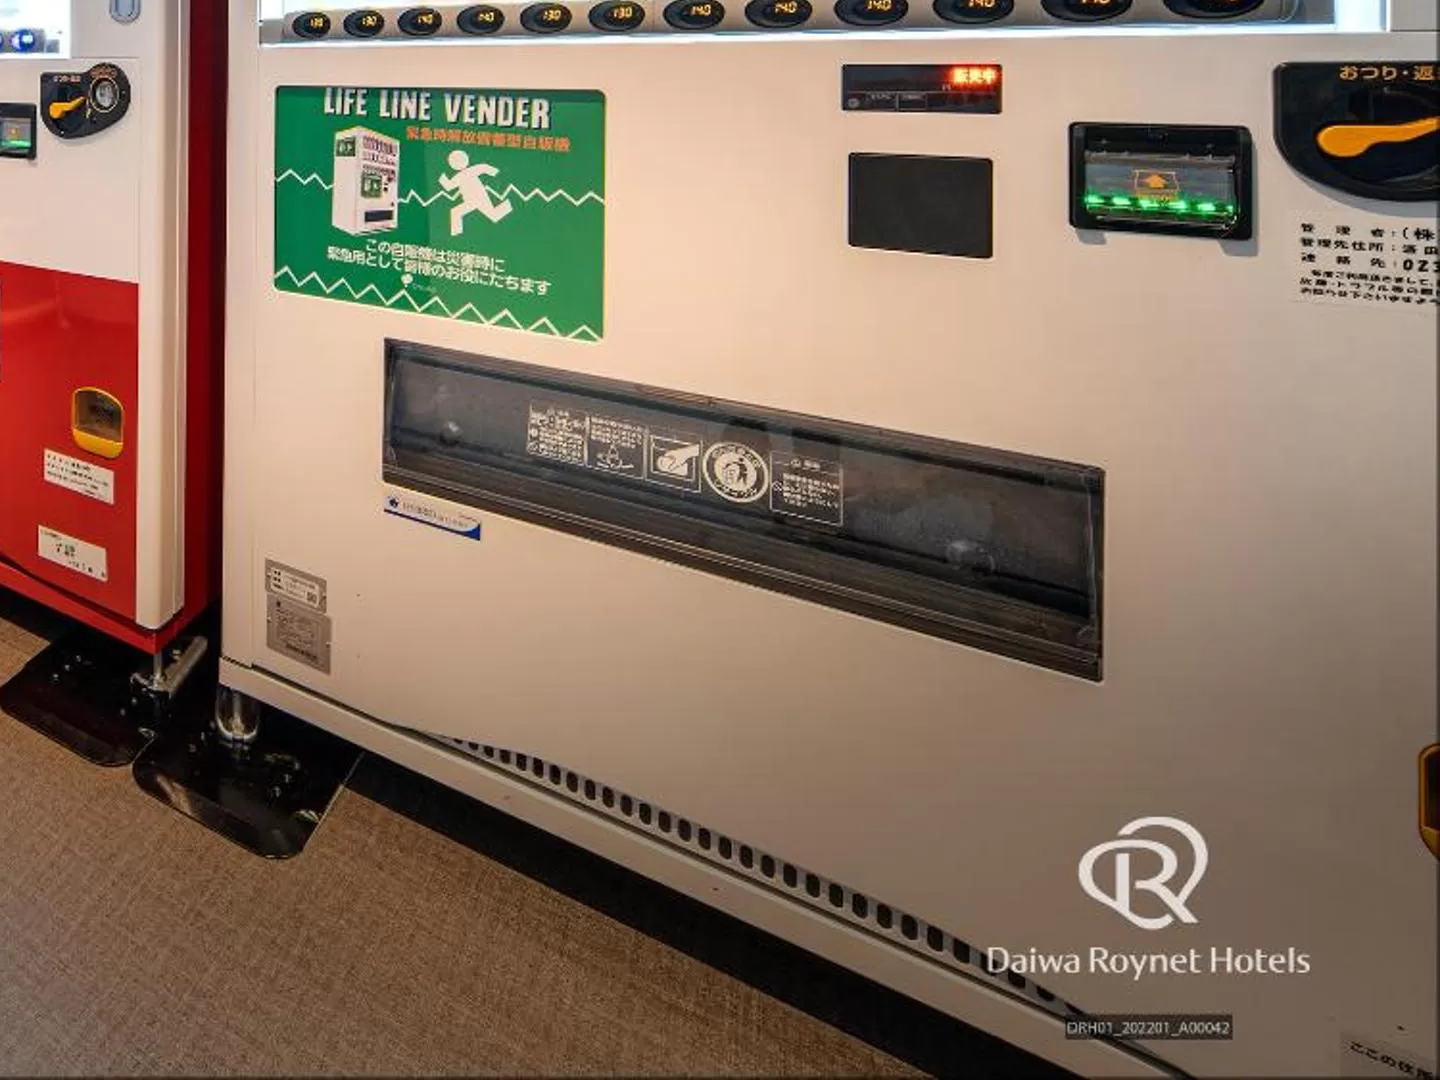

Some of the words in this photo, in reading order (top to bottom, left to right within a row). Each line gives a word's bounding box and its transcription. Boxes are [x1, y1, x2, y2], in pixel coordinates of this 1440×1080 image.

[775, 1, 799, 14] 140
[323, 87, 368, 116] LIFE
[379, 89, 432, 120] LINE
[444, 92, 551, 129] VENDER
[365, 238, 506, 273] この自販機は災害時に
